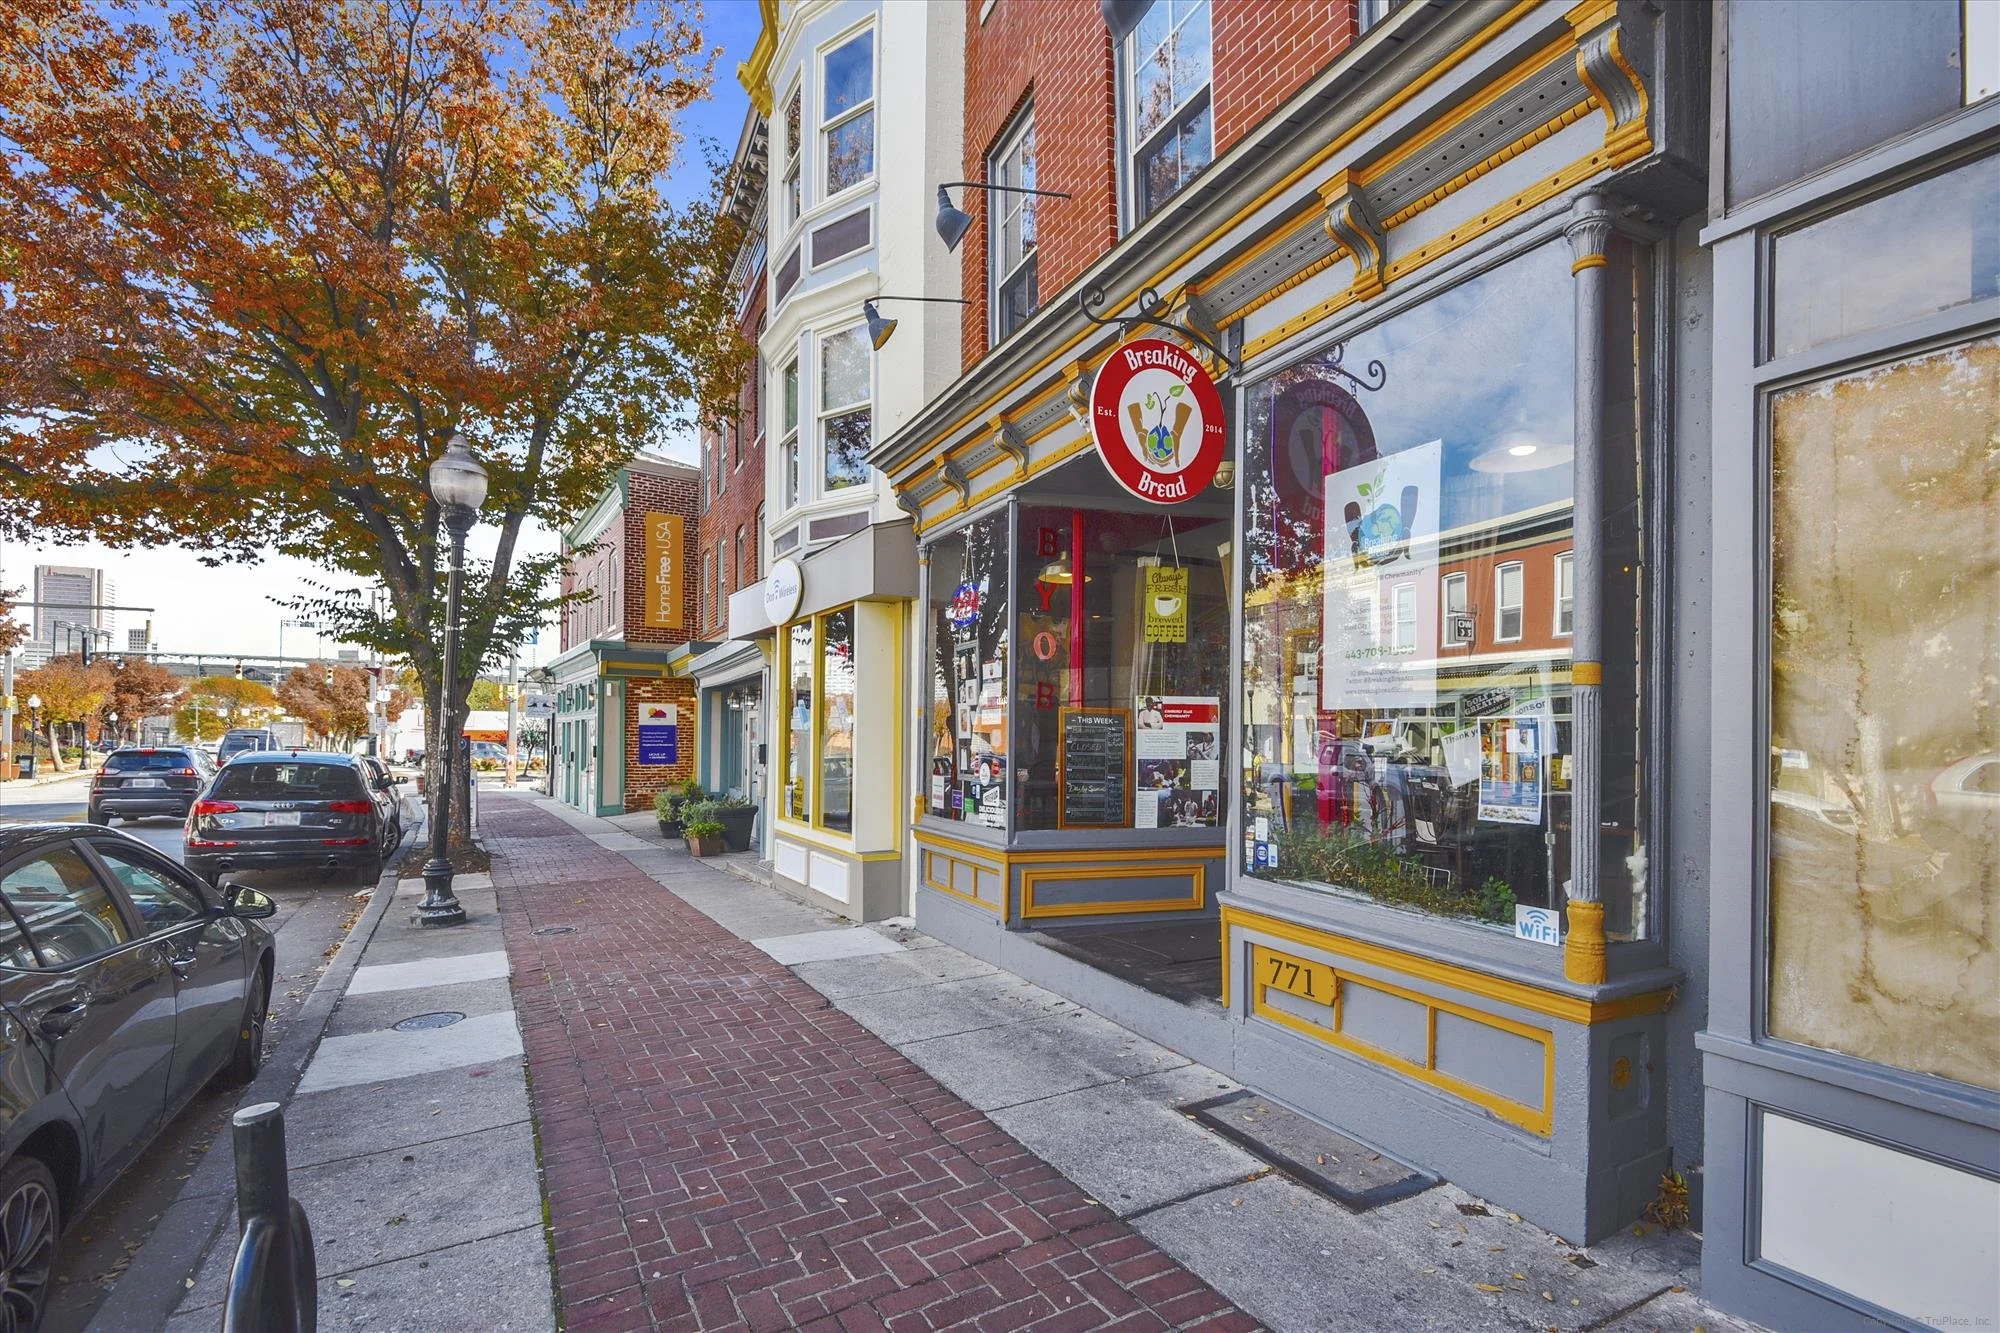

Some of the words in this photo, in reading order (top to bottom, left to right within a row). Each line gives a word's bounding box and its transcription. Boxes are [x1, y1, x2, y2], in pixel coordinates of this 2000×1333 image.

[1124, 346, 1198, 384] Breaking
[1097, 406, 1116, 417] Est.
[1205, 424, 1222, 434] 2014
[1138, 471, 1187, 498] Bread
[1152, 572, 1183, 585] Always
[1146, 584, 1188, 594] FRESH
[1148, 612, 1183, 623] brewed
[1146, 625, 1184, 637] COFFEE
[1519, 921, 1557, 944] WiFi
[1269, 957, 1315, 998] 771
